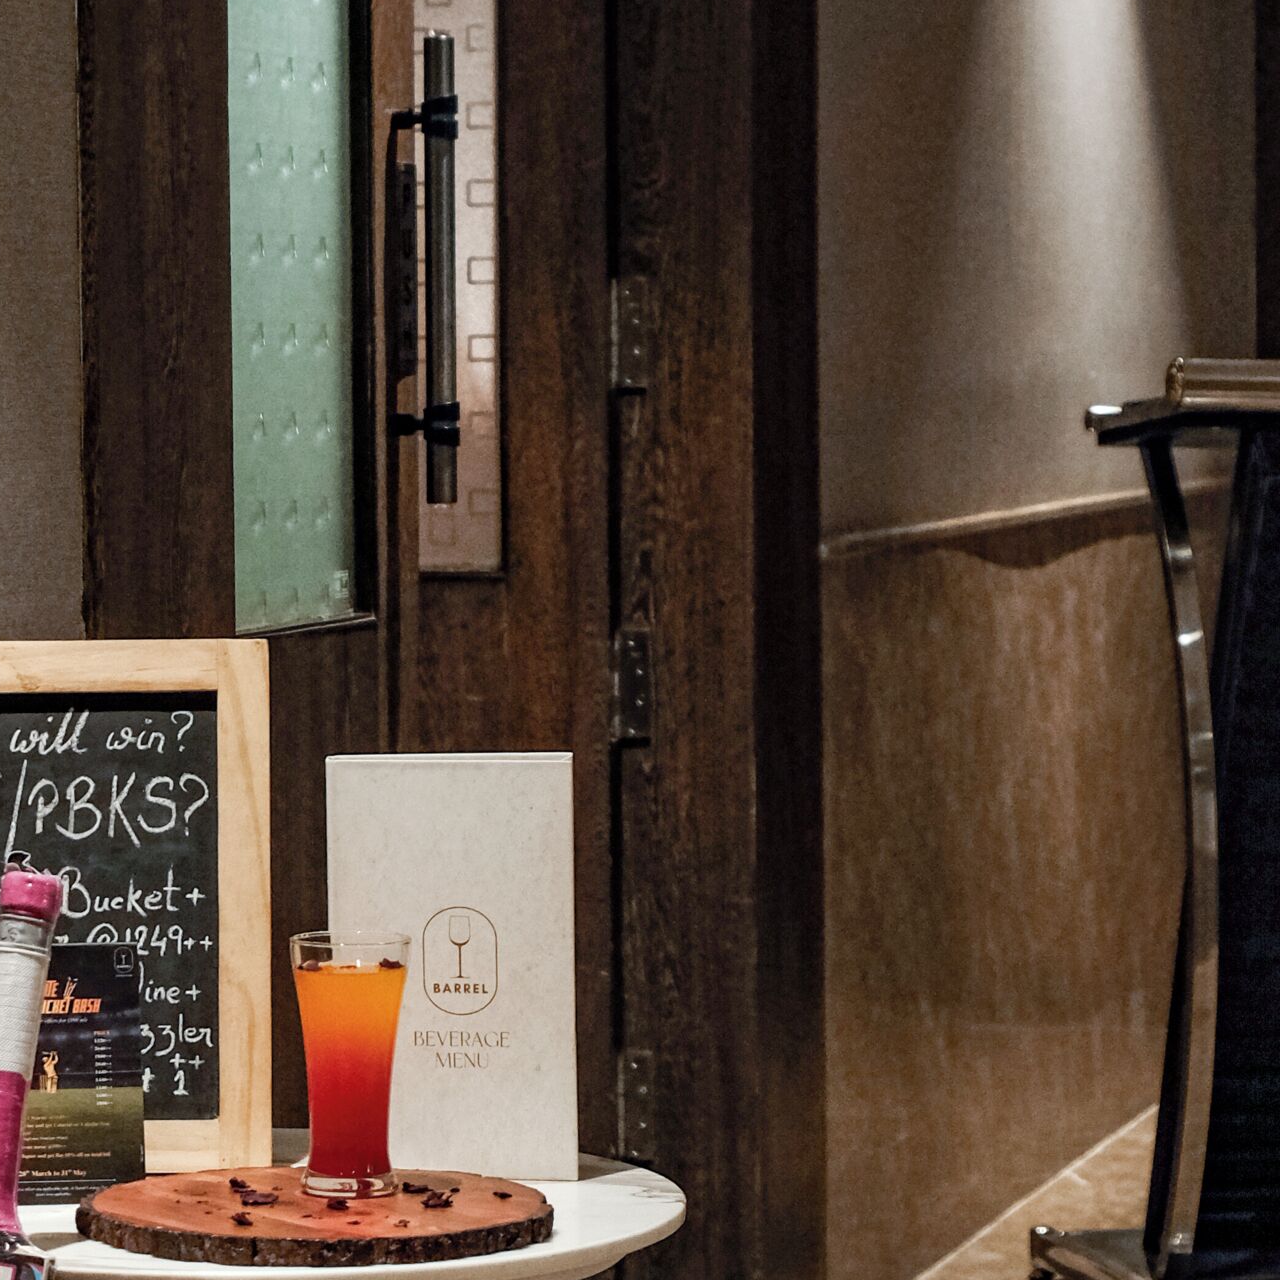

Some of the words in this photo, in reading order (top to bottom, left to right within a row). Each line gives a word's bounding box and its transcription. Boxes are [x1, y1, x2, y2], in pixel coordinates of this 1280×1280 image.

[9, 707, 90, 755] will
[106, 711, 195, 754] win?
[433, 983, 488, 994] BARREL
[413, 1030, 510, 1048] BEVERAGE
[435, 1052, 489, 1069] MENU
